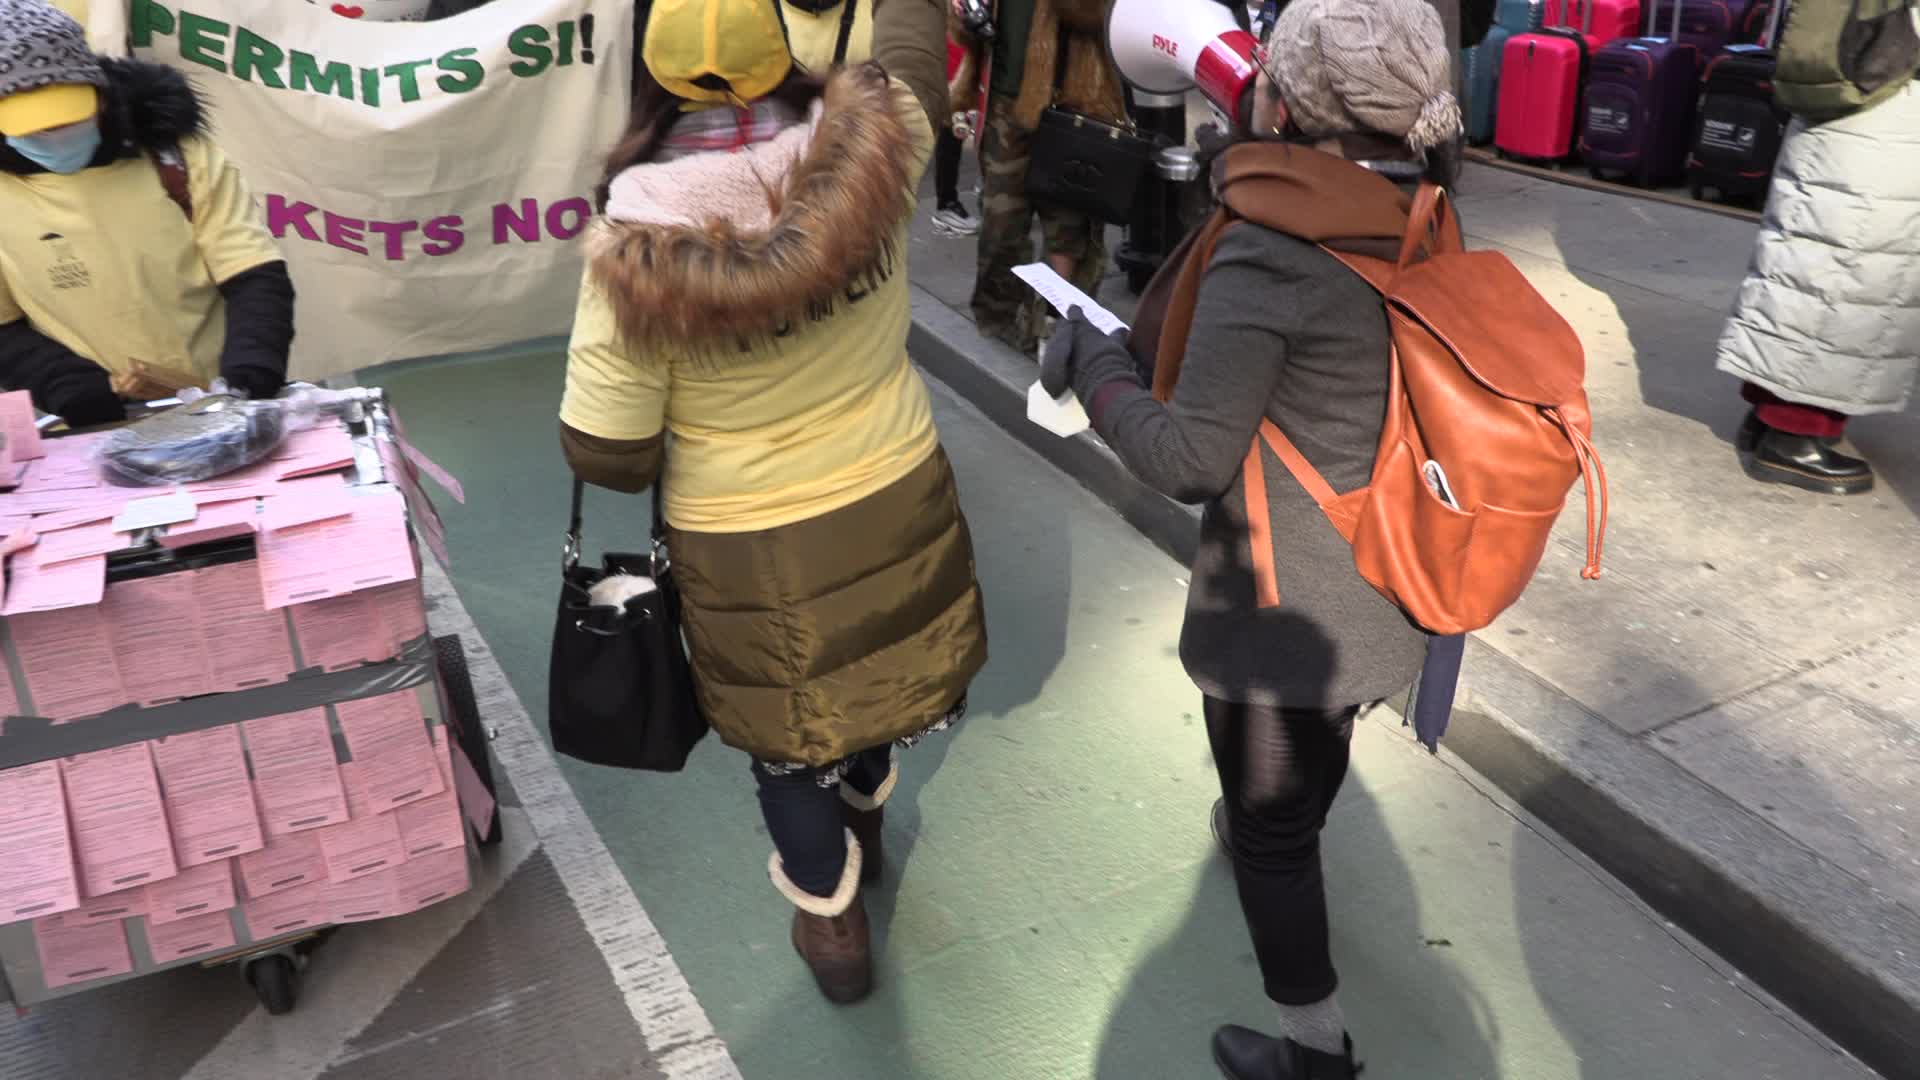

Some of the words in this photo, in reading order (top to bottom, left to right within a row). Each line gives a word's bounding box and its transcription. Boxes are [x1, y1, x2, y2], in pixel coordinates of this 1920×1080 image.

[130, 0, 484, 107] PERMITS
[507, 13, 595, 78] SI!
[1152, 33, 1178, 57] PYLE
[265, 193, 465, 261] KETS
[492, 196, 592, 245] NO
